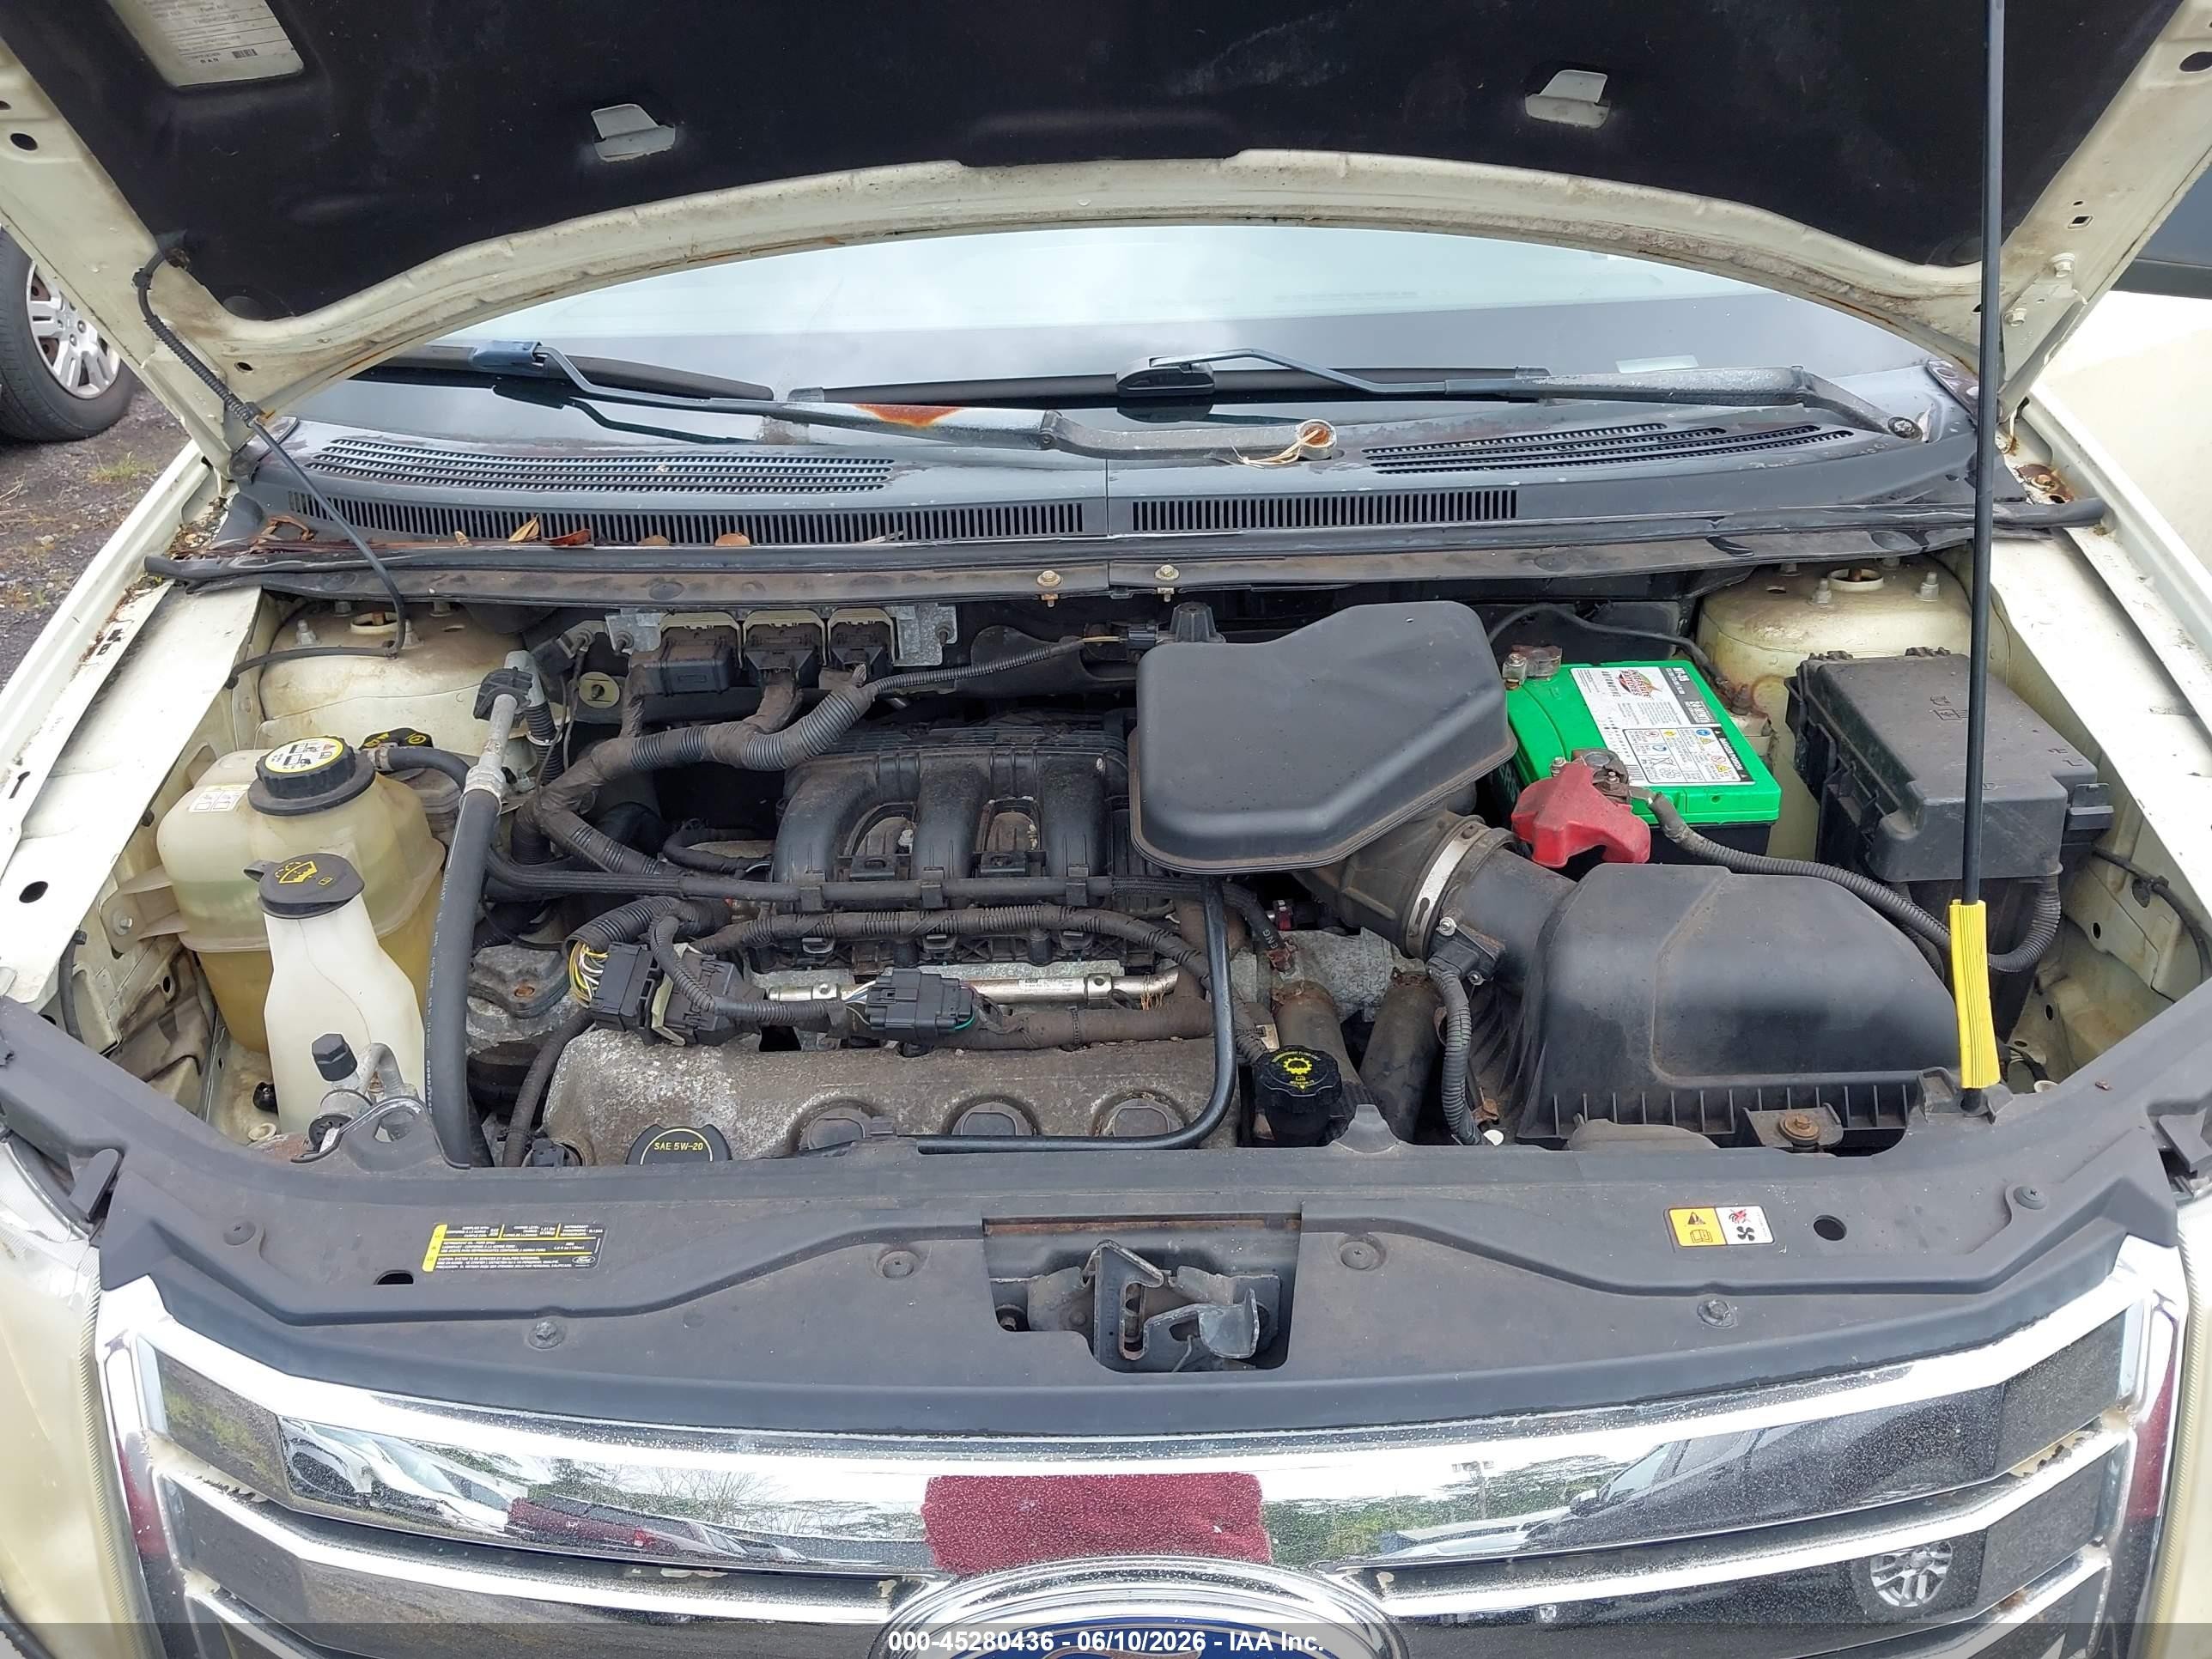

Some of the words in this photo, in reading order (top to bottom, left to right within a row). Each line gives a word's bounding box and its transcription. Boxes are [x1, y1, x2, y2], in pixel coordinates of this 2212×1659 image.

[1601, 671, 1621, 697] AUTOMOTIVE
[1262, 928, 1279, 949] ENG
[653, 1142, 672, 1151] SAE
[673, 1142, 703, 1151] 5W-20
